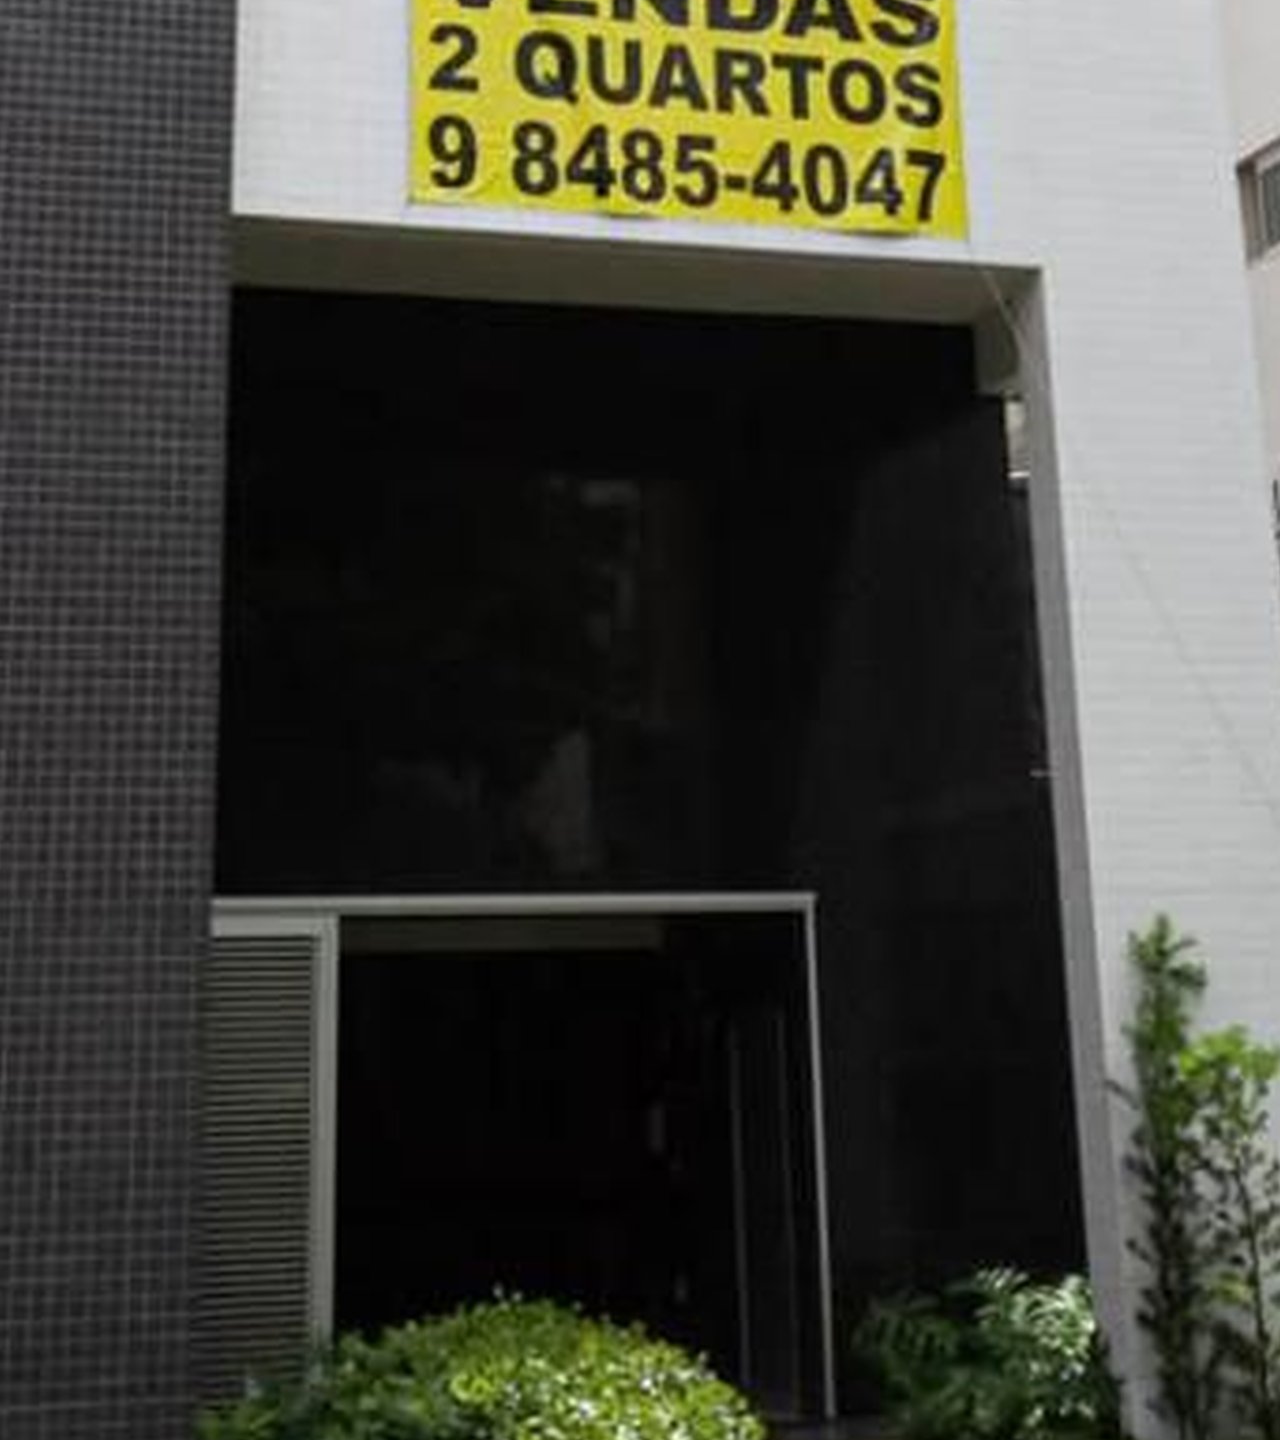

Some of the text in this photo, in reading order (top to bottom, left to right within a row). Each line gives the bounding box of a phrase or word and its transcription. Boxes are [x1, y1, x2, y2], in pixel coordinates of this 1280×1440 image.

[429, 24, 942, 128] 2 QUARTOS
[428, 115, 946, 221] 9 8485-4047
